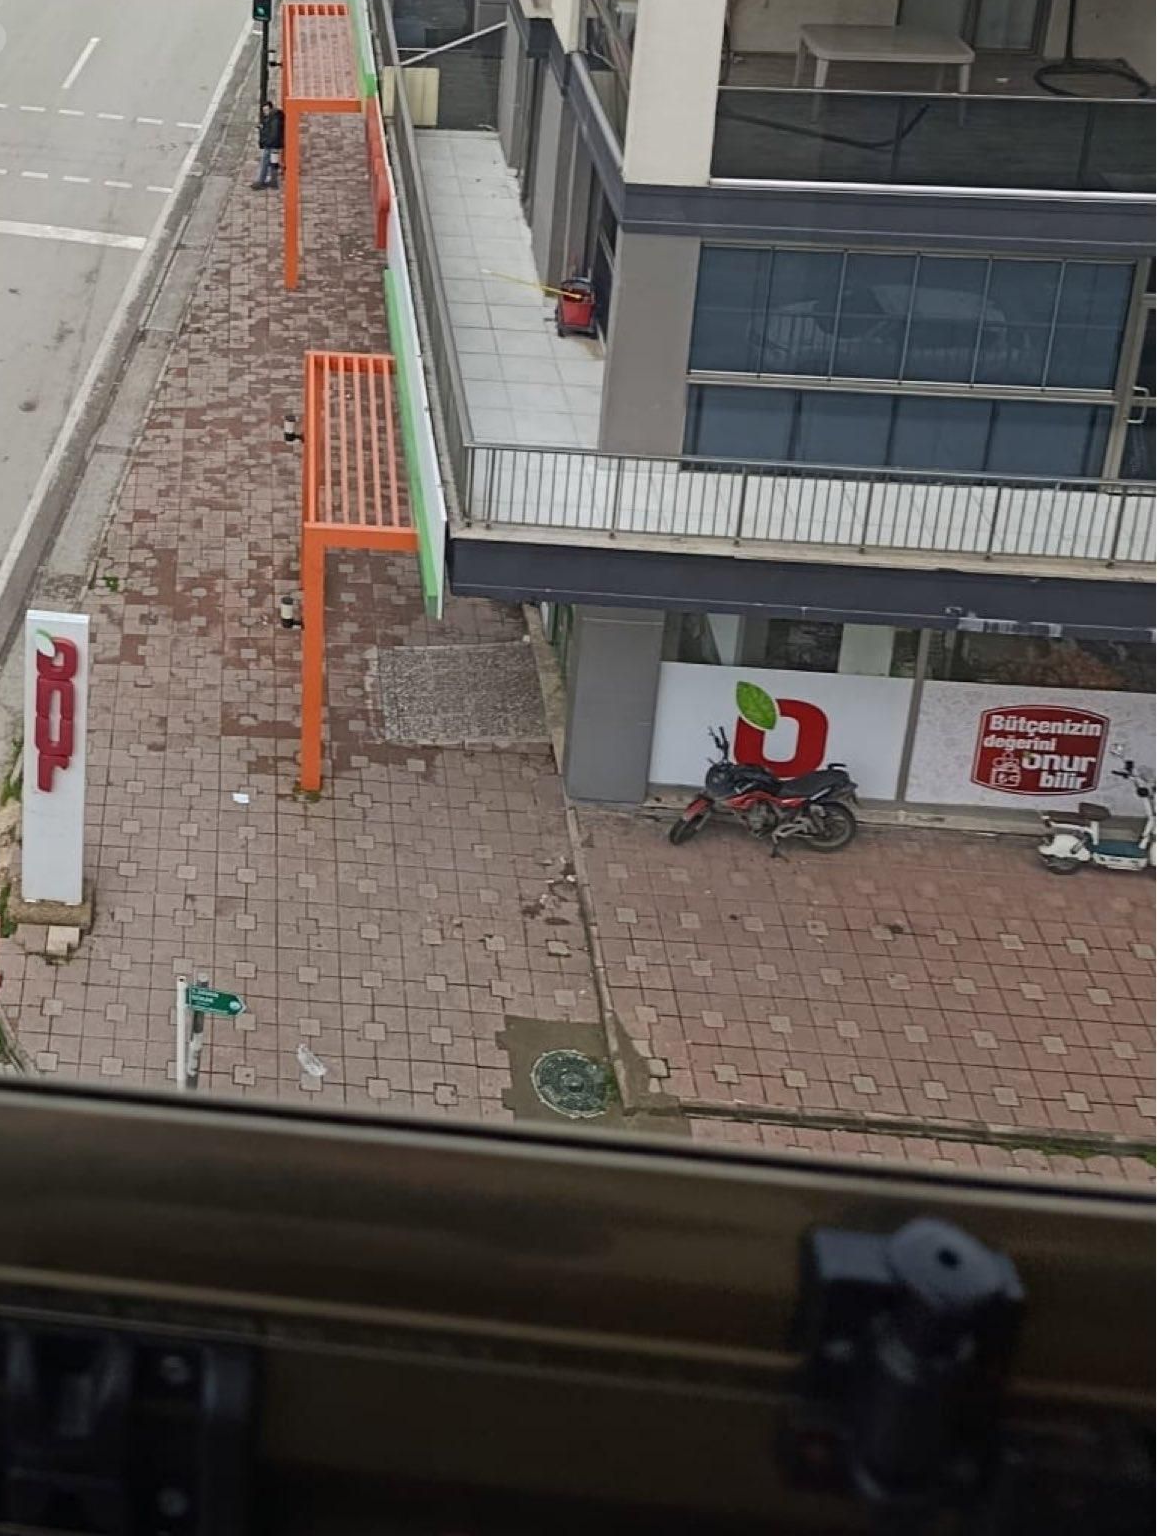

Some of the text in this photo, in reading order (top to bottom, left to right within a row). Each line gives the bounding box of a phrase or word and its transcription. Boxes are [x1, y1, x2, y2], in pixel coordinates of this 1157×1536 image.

[989, 714, 1102, 737] Bütçenizin
[983, 734, 1057, 751] değerini
[1021, 751, 1097, 773] onur
[1039, 771, 1087, 790] bilir
